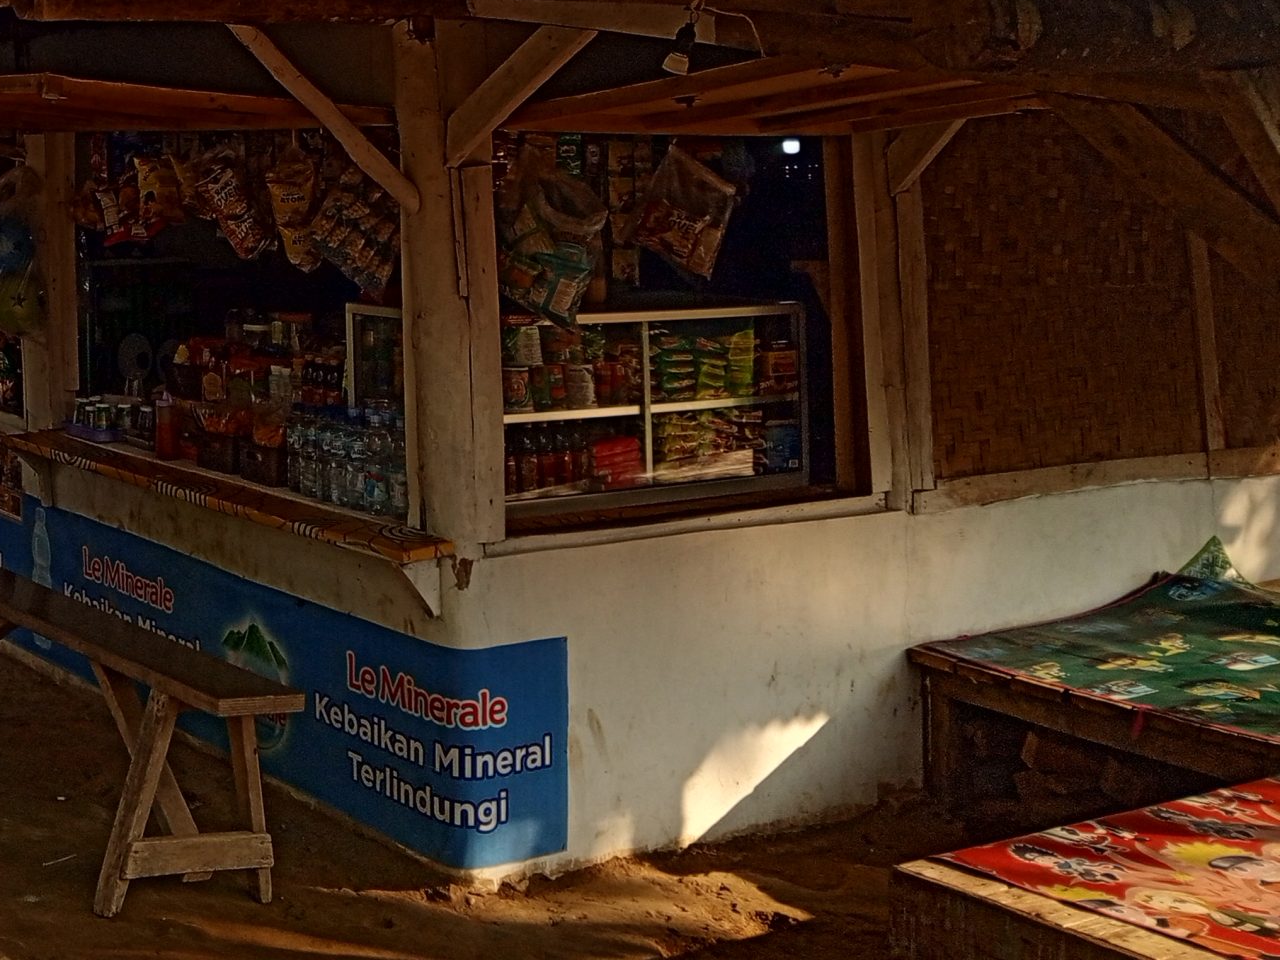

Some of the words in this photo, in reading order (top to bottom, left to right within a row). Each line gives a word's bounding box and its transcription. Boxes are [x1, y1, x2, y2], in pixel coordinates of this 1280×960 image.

[81, 544, 102, 585] Le
[103, 555, 175, 614] Minerale
[345, 650, 377, 699] Le
[379, 664, 509, 730] Minerale
[313, 693, 425, 767] Kebaikan
[433, 733, 553, 780] Mineral
[346, 749, 510, 833] Terlindungi
